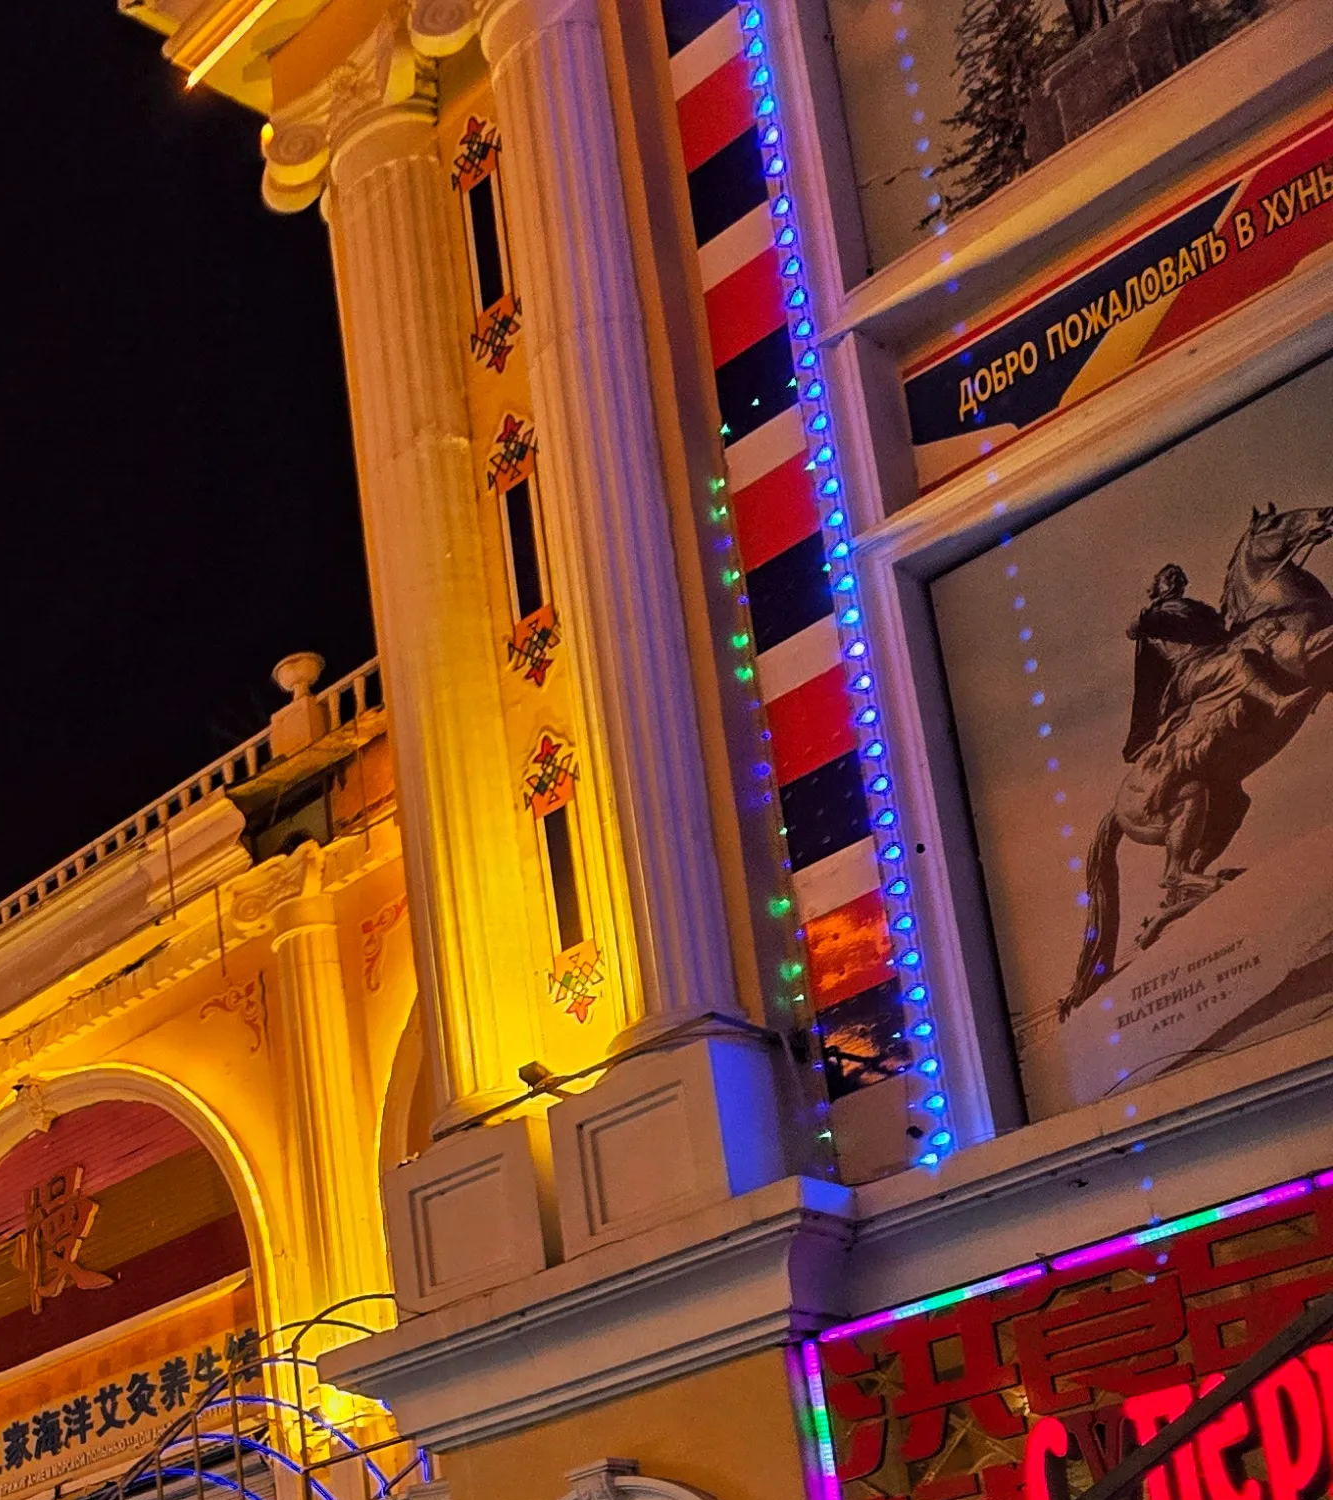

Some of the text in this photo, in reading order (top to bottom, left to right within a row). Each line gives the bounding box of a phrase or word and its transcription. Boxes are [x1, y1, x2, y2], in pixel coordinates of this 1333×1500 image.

[957, 341, 1038, 422] ДОБРО
[1046, 232, 1227, 361] ПОЖАЛОВАТЬ
[1235, 210, 1255, 251] В
